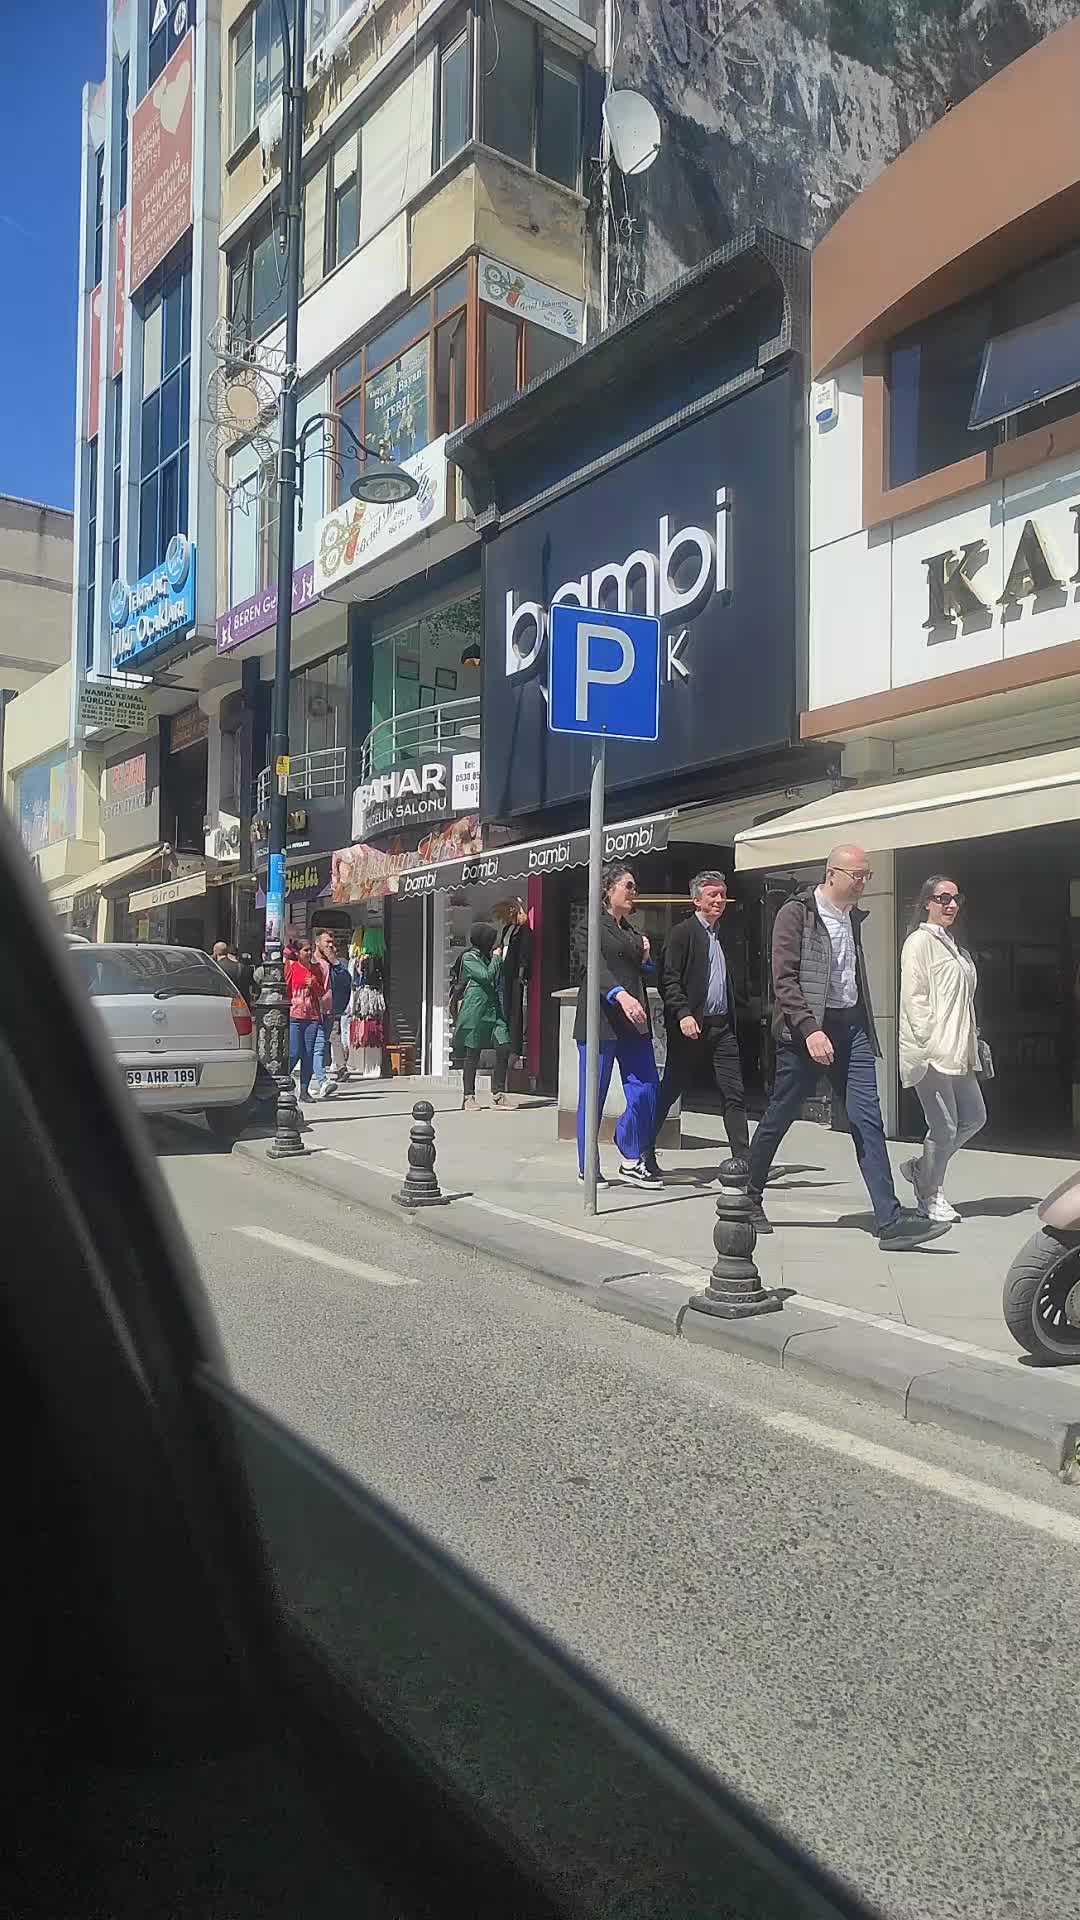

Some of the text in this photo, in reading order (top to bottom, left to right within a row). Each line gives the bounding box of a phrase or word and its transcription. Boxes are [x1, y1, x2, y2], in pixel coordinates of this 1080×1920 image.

[920, 503, 1080, 632] KA
[233, 601, 261, 630] BEREN
[575, 622, 636, 722] P
[118, 701, 147, 711] KURSU
[395, 797, 447, 818] SALONU
[604, 824, 655, 852] bambi
[528, 842, 571, 868] bambi
[404, 871, 438, 892] bambi
[461, 857, 499, 881] bambi
[128, 1070, 194, 1085] 59 AHR 189
